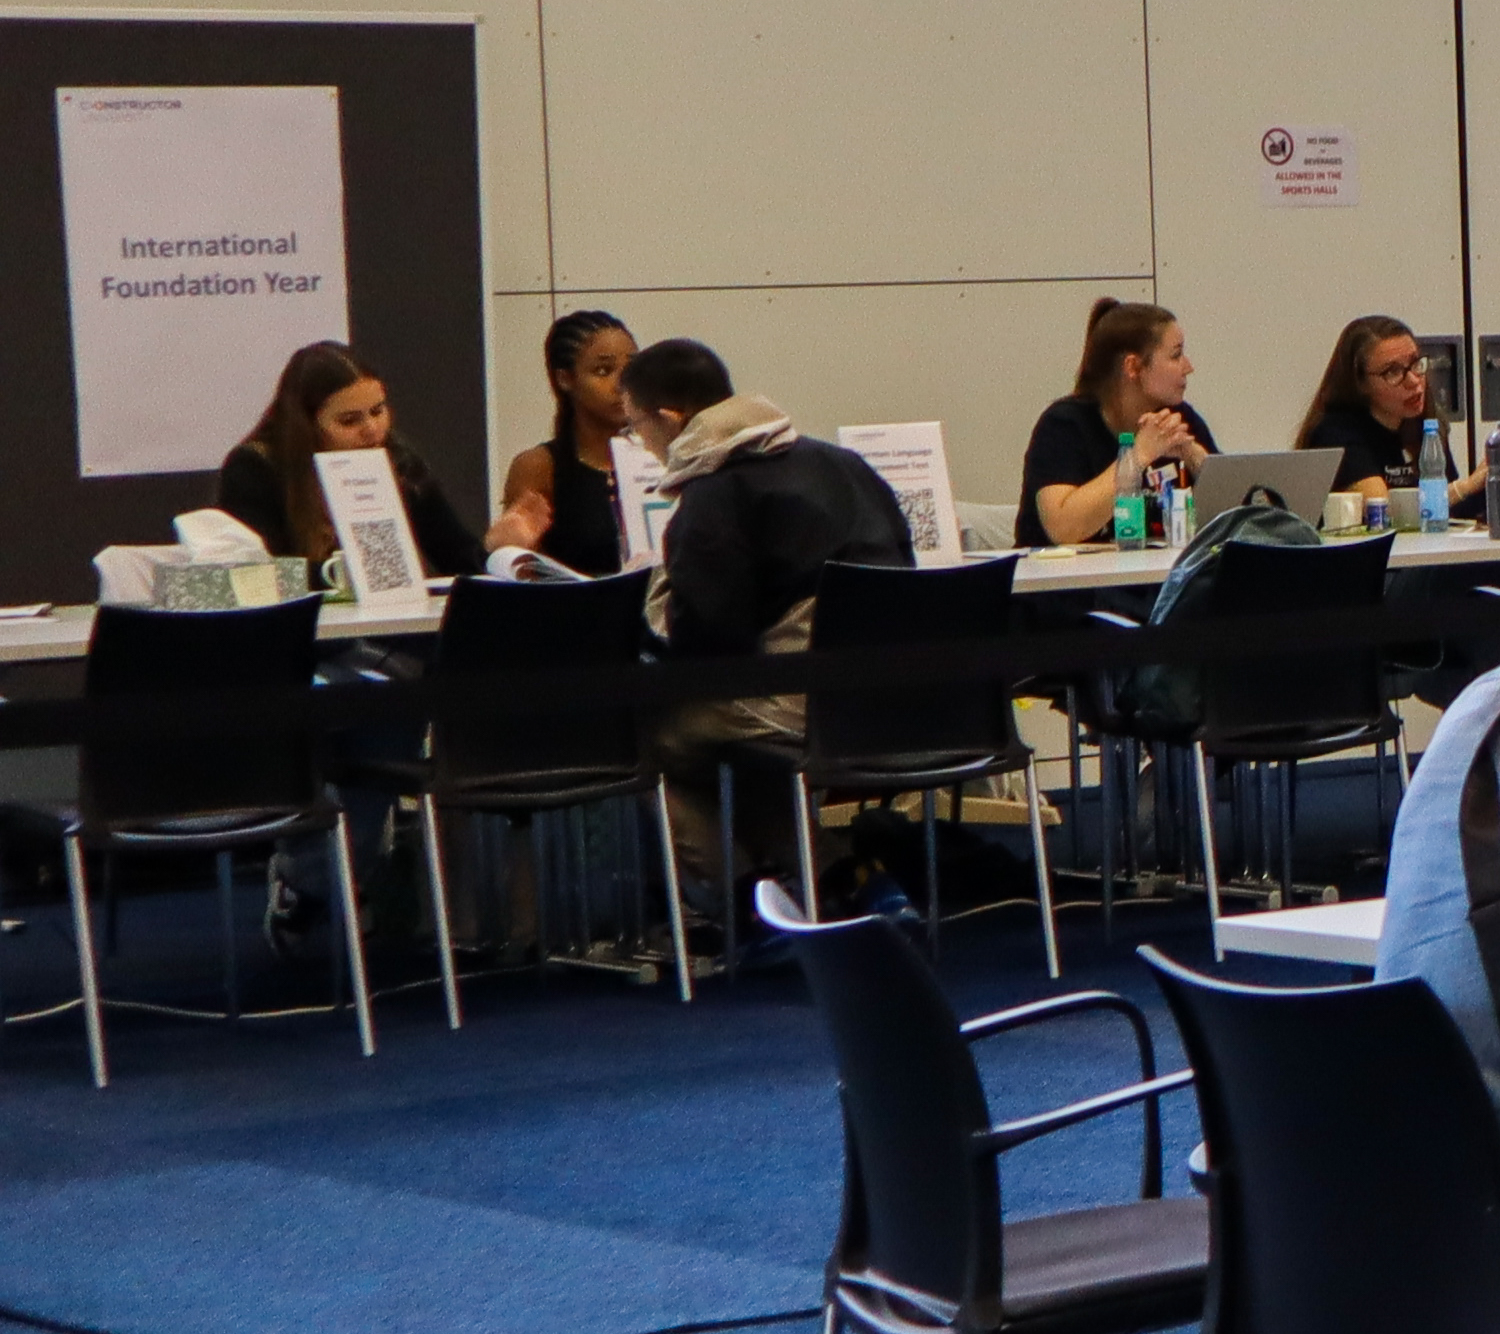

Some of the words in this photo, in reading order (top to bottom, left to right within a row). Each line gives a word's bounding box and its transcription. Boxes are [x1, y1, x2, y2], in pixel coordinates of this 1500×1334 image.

[1275, 171, 1315, 181] ALLOWED
[1313, 184, 1338, 195] HALLS
[121, 232, 297, 259] International
[101, 274, 255, 300] Foundation
[263, 271, 322, 294] Year
